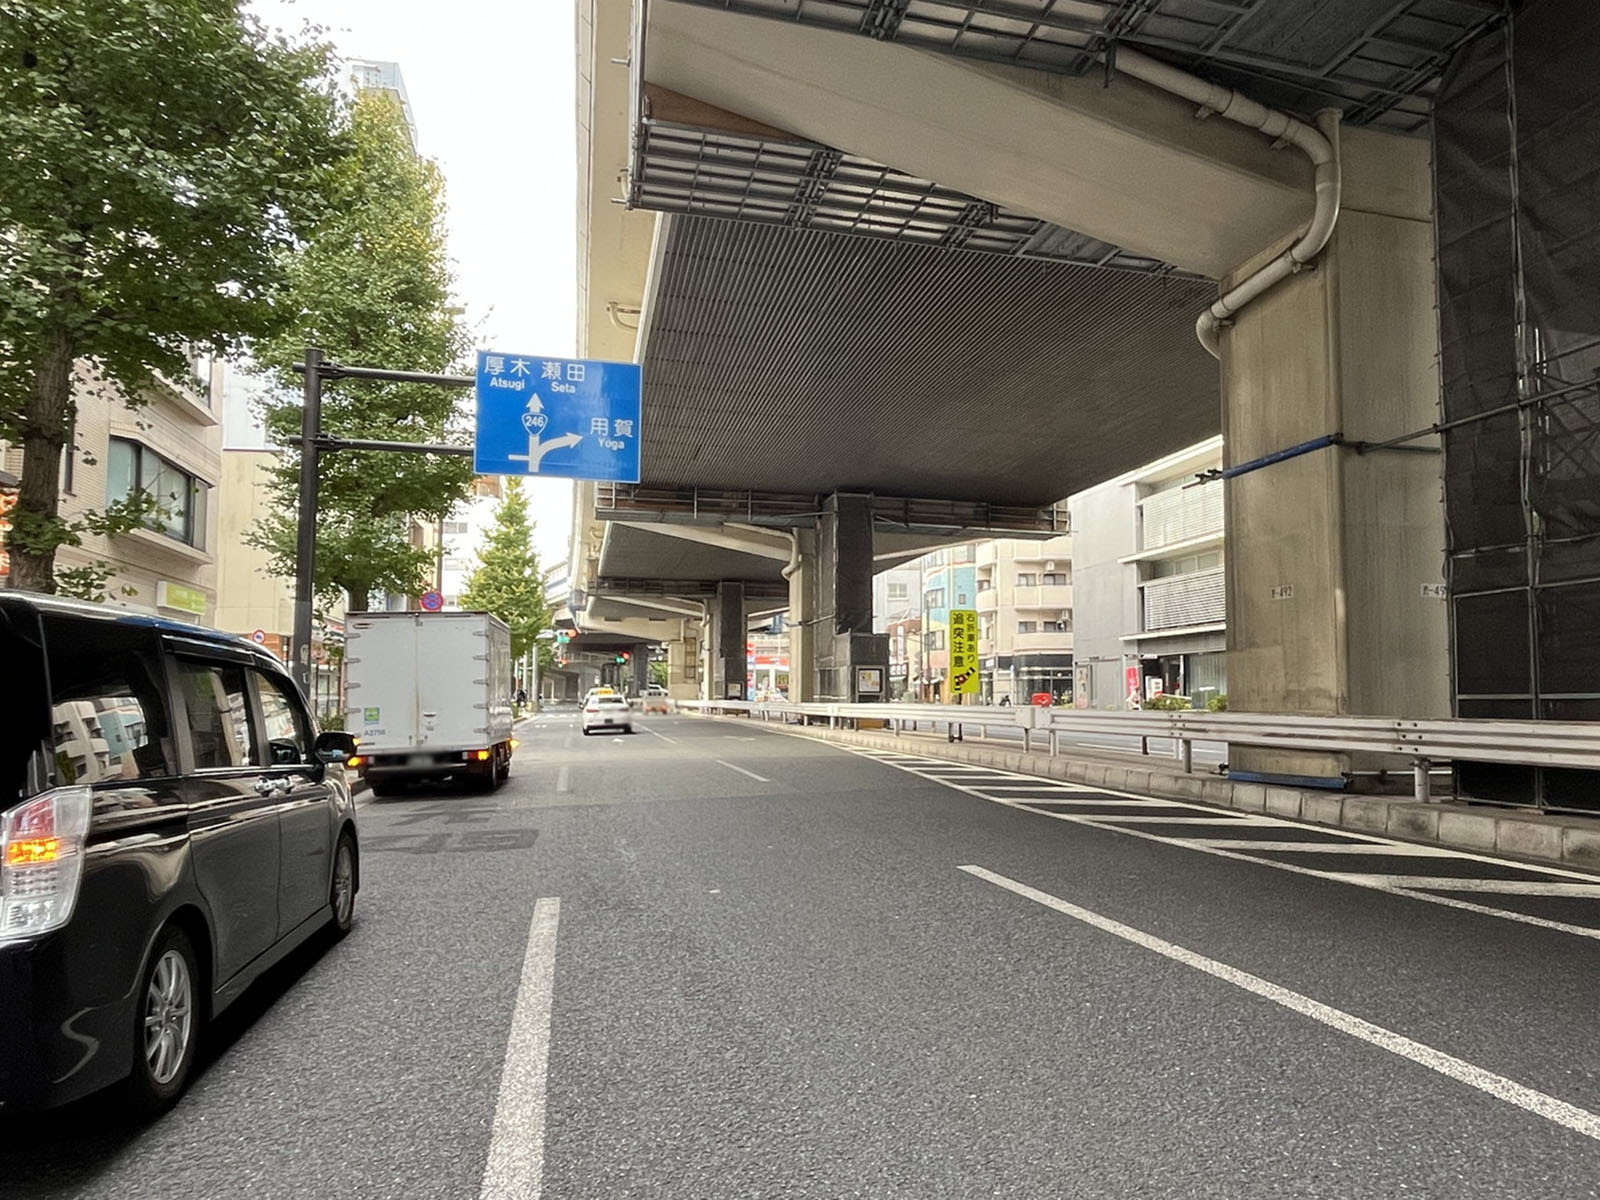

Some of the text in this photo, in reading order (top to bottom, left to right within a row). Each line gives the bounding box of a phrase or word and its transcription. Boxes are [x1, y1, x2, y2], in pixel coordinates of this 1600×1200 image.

[484, 356, 531, 377] 厚木
[541, 361, 585, 382] 瀬田
[490, 377, 525, 391] Atsugi
[551, 382, 576, 393] Seta
[525, 416, 544, 427] 246
[590, 417, 633, 438] 用賀
[598, 439, 625, 450] Yoga
[953, 613, 964, 668] 追突注意
[966, 614, 976, 663] 右折車あり
